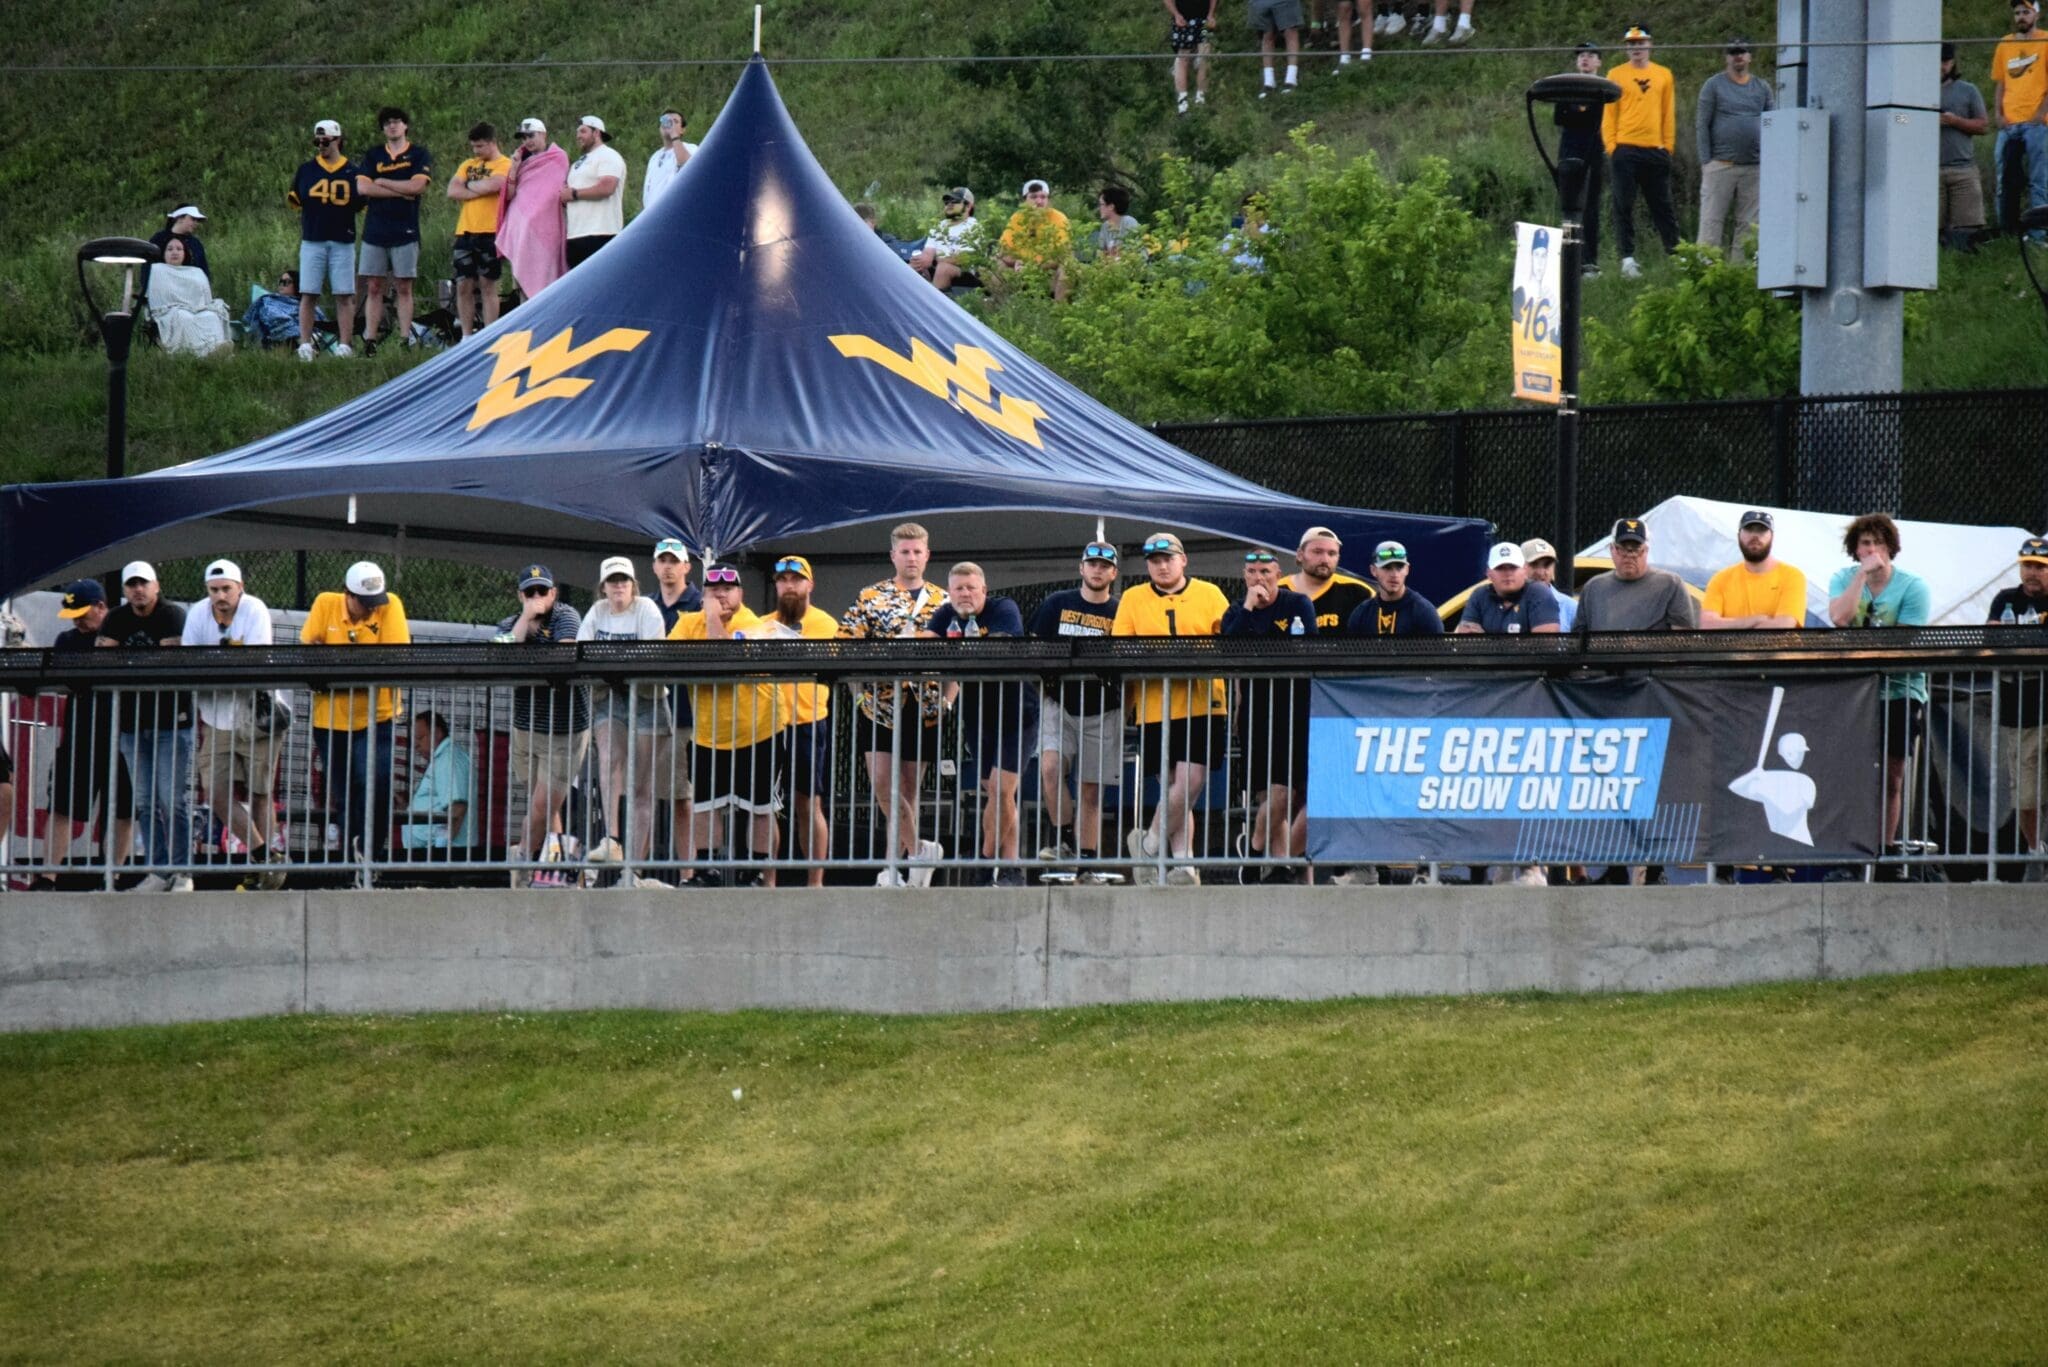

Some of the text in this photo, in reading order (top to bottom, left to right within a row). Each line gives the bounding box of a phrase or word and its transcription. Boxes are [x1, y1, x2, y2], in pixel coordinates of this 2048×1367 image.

[309, 179, 350, 206] 40
[1524, 297, 1549, 342] 16
[1165, 609, 1177, 636] 1
[1355, 727, 1647, 773] THE GREATEST
[1418, 776, 1641, 810] SHOW ON DIRT
